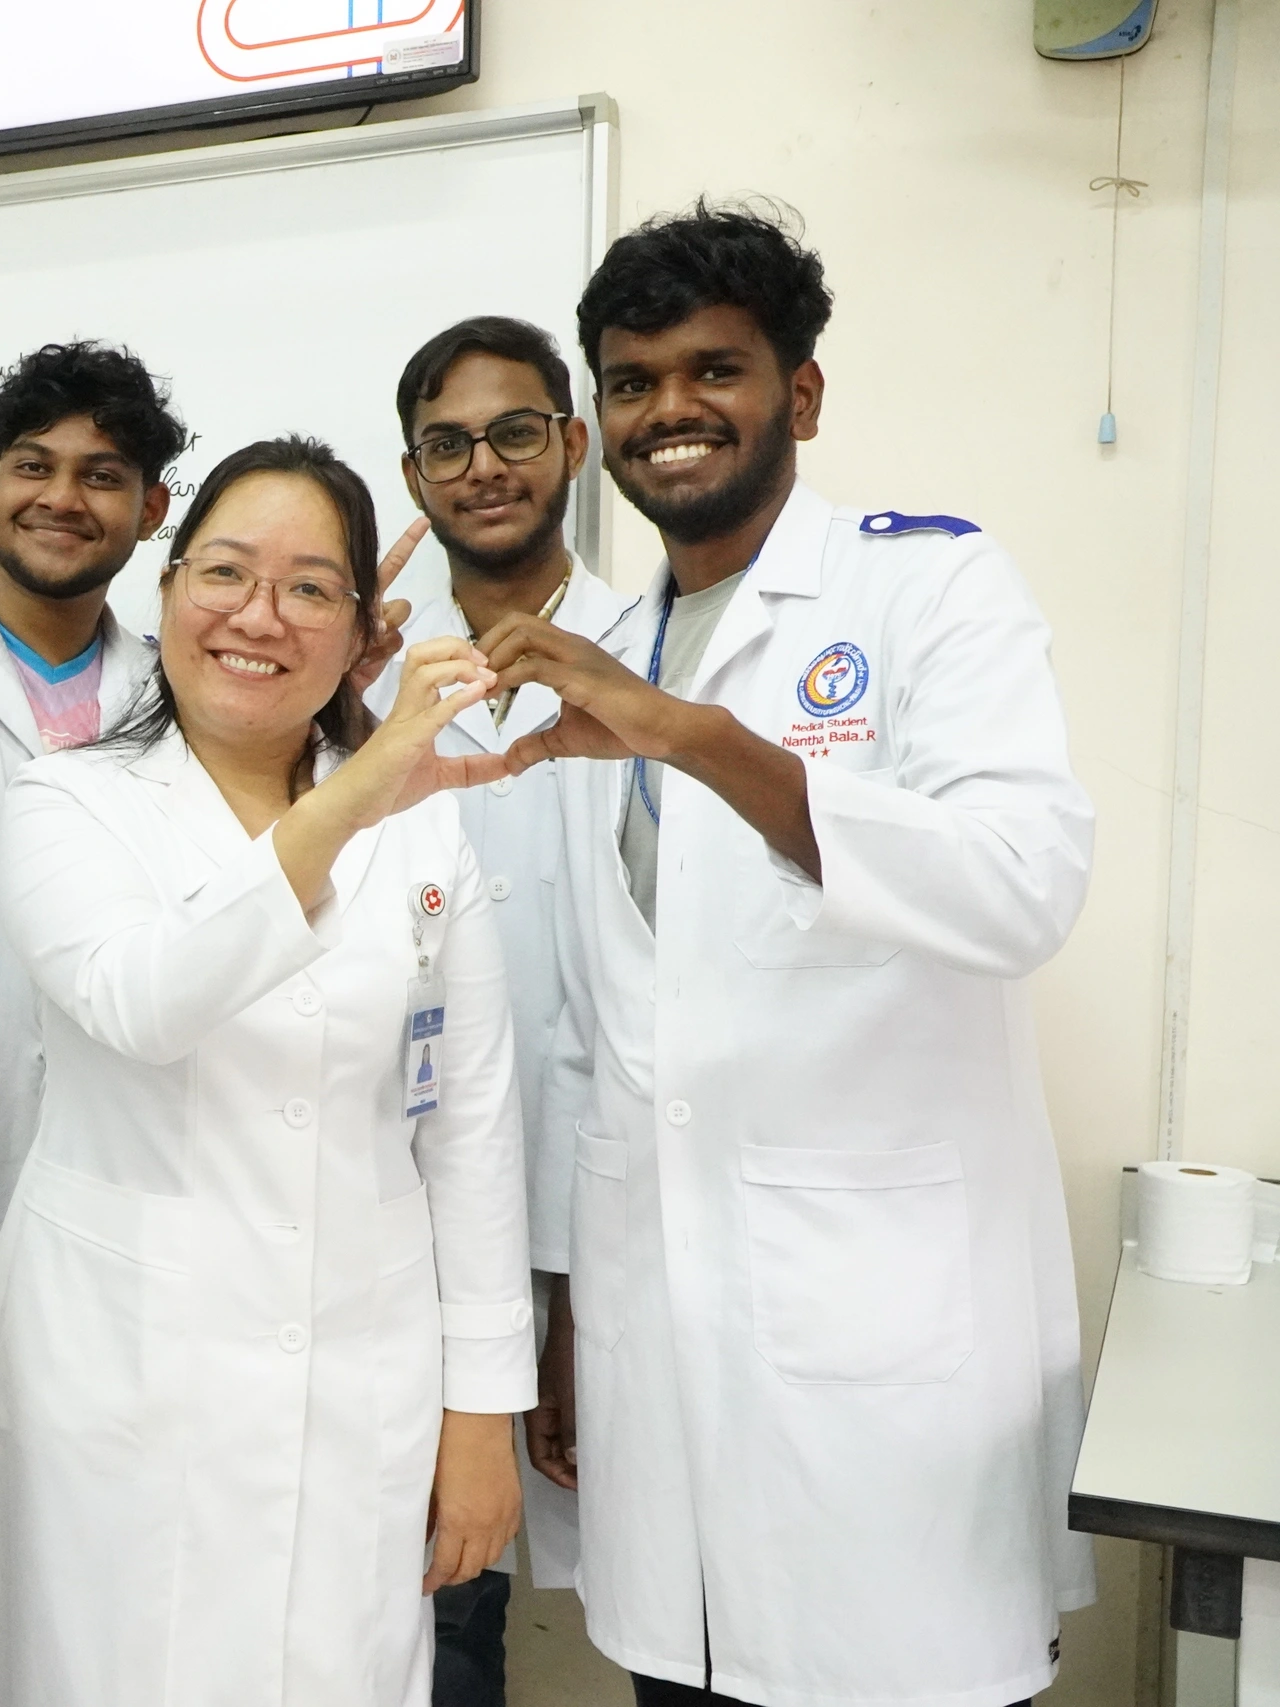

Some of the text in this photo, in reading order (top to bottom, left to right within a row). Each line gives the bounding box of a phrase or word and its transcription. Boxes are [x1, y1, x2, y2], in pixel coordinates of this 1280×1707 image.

[791, 716, 869, 732] Medical Student
[781, 735, 825, 748] Nantha
